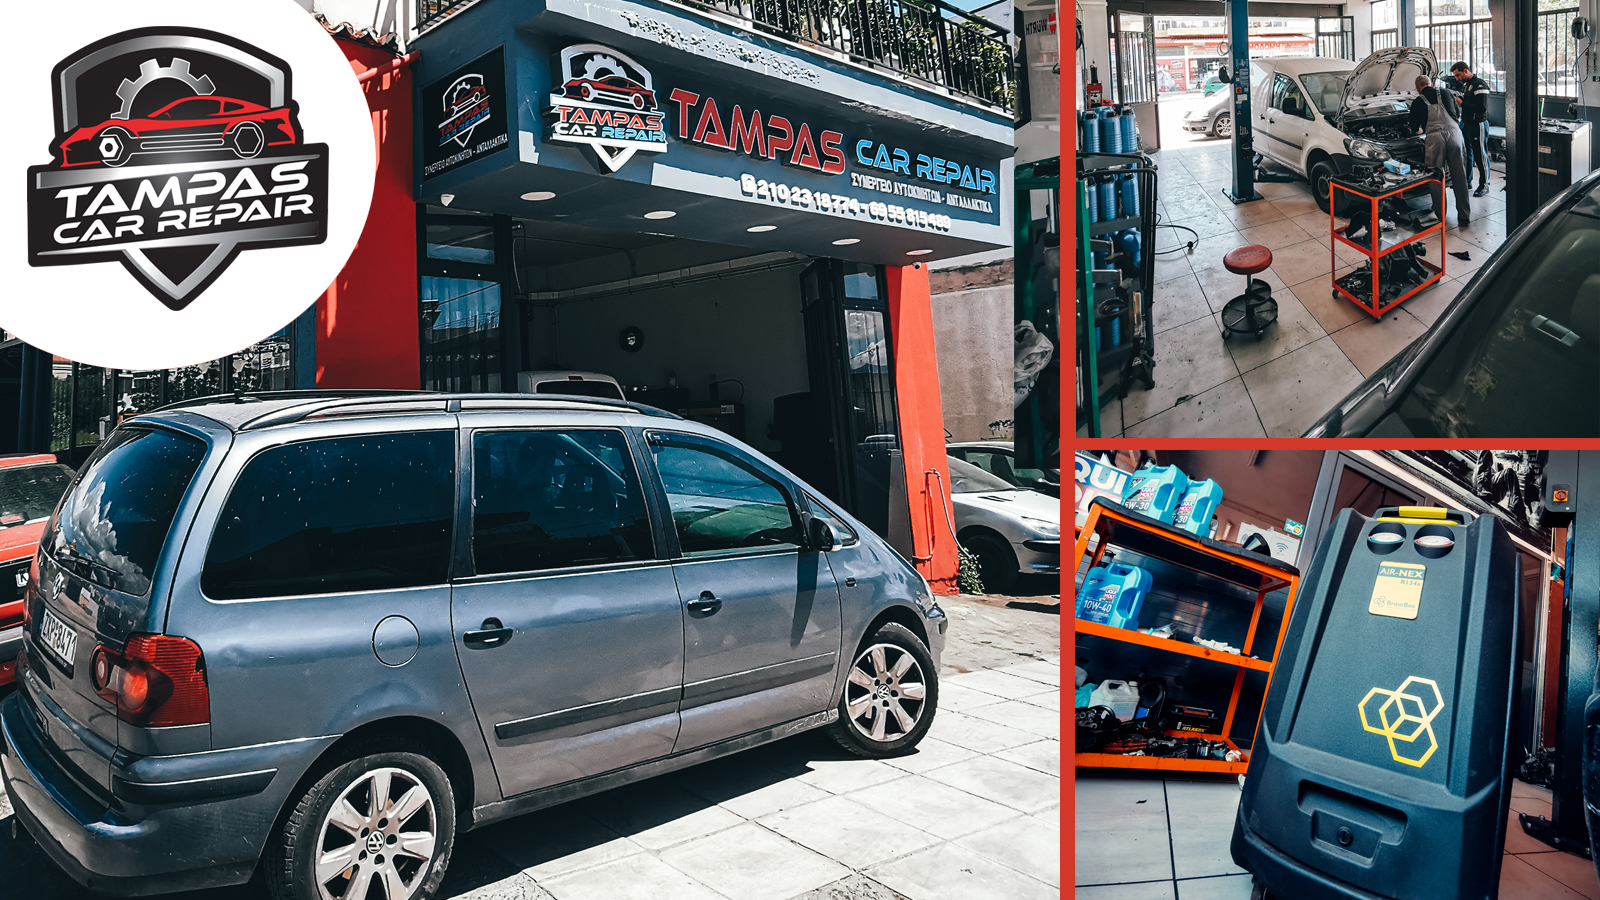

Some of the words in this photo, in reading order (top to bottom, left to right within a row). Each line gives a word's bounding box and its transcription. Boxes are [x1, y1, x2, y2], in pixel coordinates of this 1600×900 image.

[440, 99, 489, 136] TAMPAS
[440, 129, 457, 143] CAR
[459, 107, 490, 131] REPAIR
[557, 106, 664, 132] TAMPAS
[554, 122, 597, 137] CAR
[601, 127, 666, 142] REPAIR
[670, 87, 846, 175] TAMPAS
[856, 139, 910, 175] CAR
[916, 154, 996, 194] REPAIR
[757, 180, 790, 200] 210
[851, 172, 892, 194] ΣΥΝΕΡΓΕΙΟ
[1379, 567, 1423, 579] AIR-NEX
[1083, 600, 1112, 613] 10W-40
